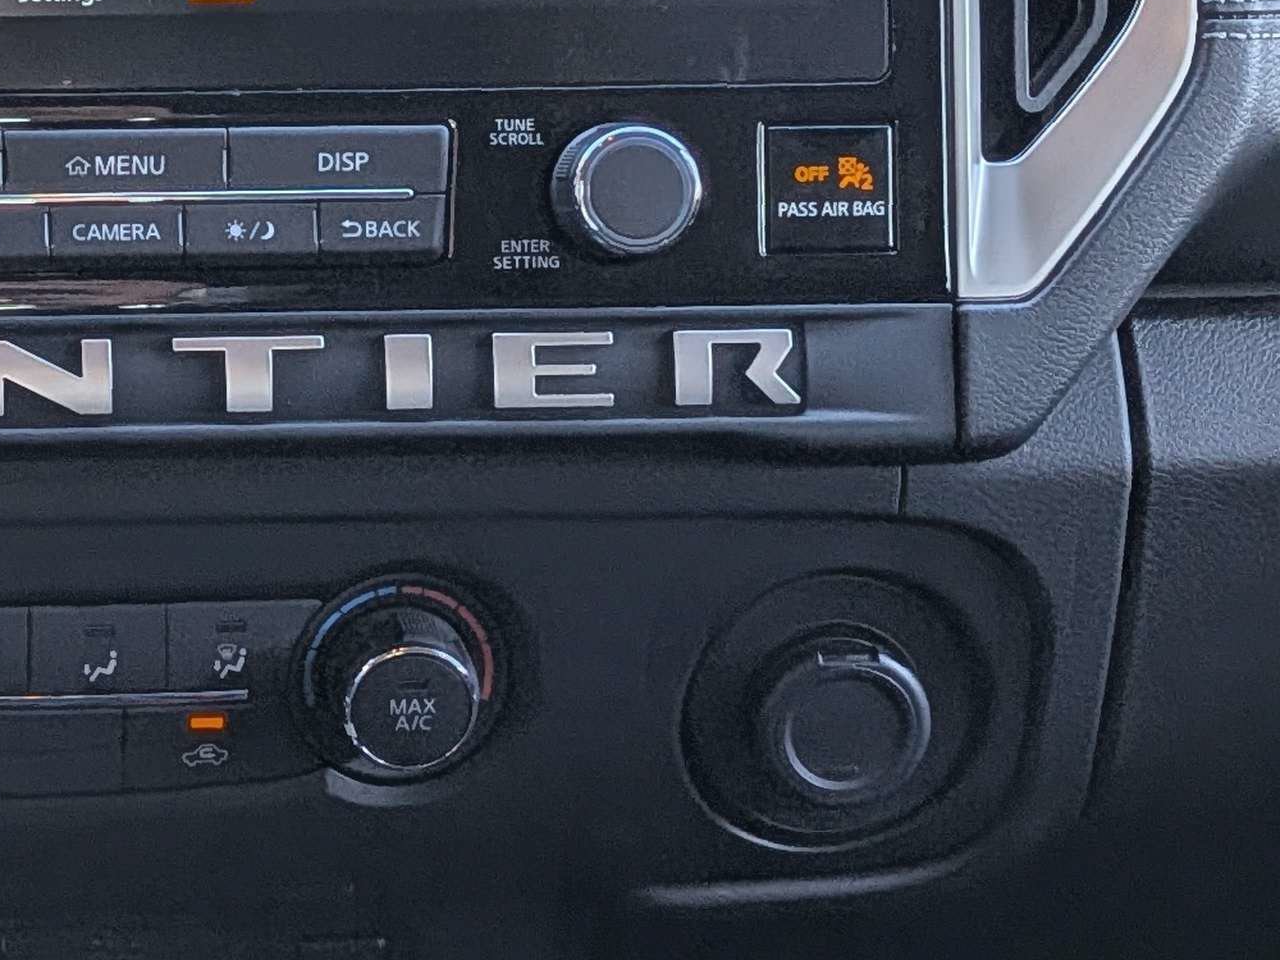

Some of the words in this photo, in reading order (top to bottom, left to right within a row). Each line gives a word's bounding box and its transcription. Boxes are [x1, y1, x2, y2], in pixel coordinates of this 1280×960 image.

[495, 119, 535, 132] TUNE
[489, 132, 544, 146] SCROLL
[95, 154, 166, 176] MENU
[318, 152, 369, 172] DISP
[794, 166, 829, 182] OFF
[778, 201, 817, 217] PASS
[821, 201, 849, 216] AIR
[853, 200, 885, 216] BAG
[72, 224, 161, 242] CAMERA
[365, 220, 420, 238] BACK
[501, 240, 550, 254] ENTER
[493, 256, 560, 270] SETTING
[389, 698, 437, 716] MAX
[395, 715, 433, 731] A/C
